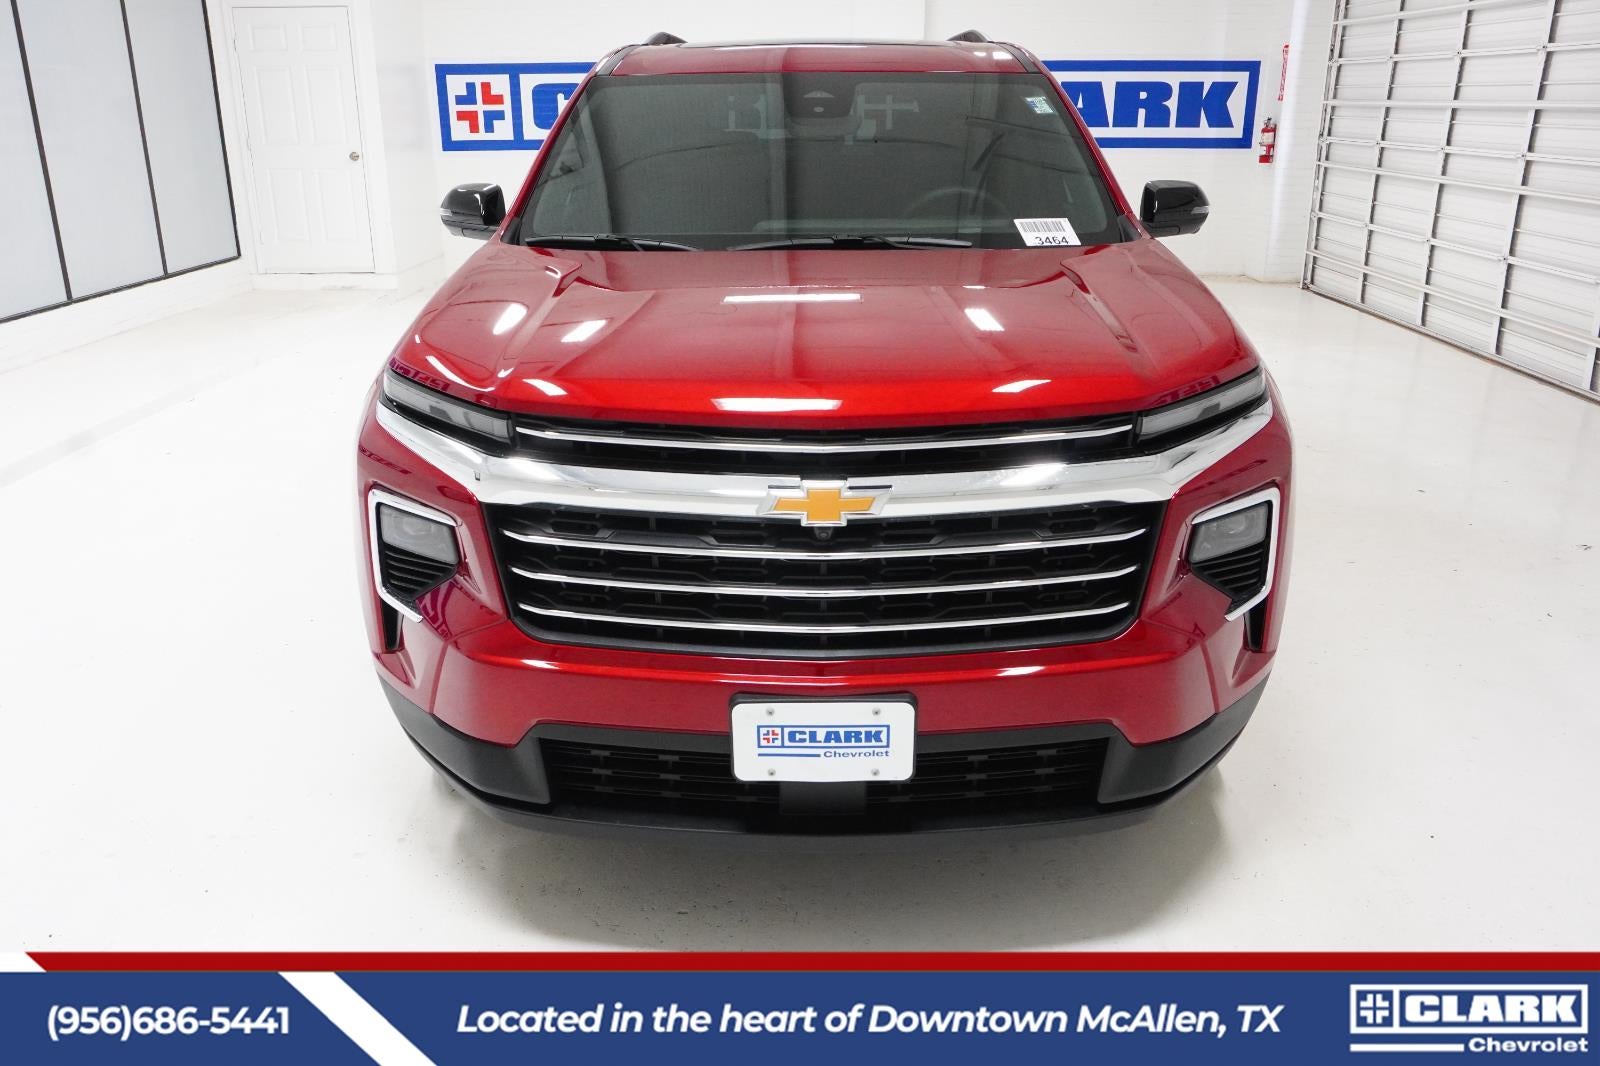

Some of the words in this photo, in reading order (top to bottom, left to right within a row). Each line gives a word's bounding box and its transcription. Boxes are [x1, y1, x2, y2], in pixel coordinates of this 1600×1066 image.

[1061, 81, 1239, 128] ARK
[1034, 236, 1069, 246] 3464
[787, 730, 884, 744] CLARK
[823, 750, 890, 758] Chevrolet
